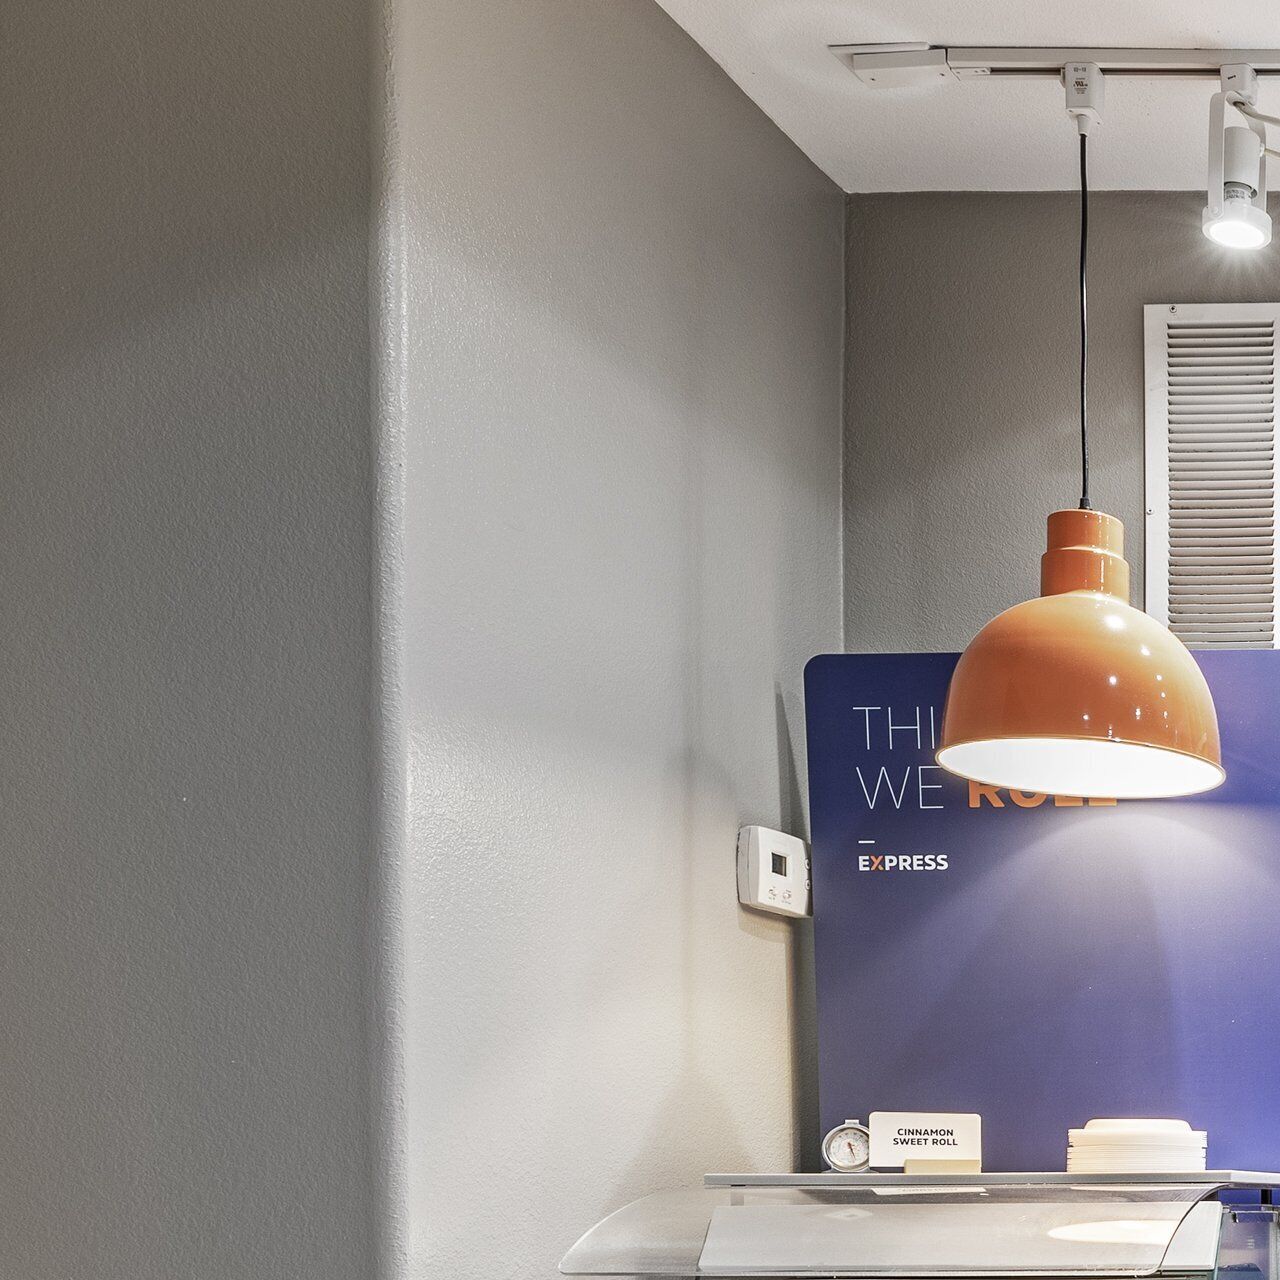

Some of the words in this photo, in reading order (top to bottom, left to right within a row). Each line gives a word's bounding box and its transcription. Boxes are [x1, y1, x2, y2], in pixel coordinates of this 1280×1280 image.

[853, 706, 935, 750] THI
[856, 766, 944, 809] WE
[858, 854, 949, 872] EXPRESS
[897, 1128, 954, 1137] CINNAMON
[892, 1138, 928, 1146] SWEET
[932, 1138, 958, 1146] ROLL
